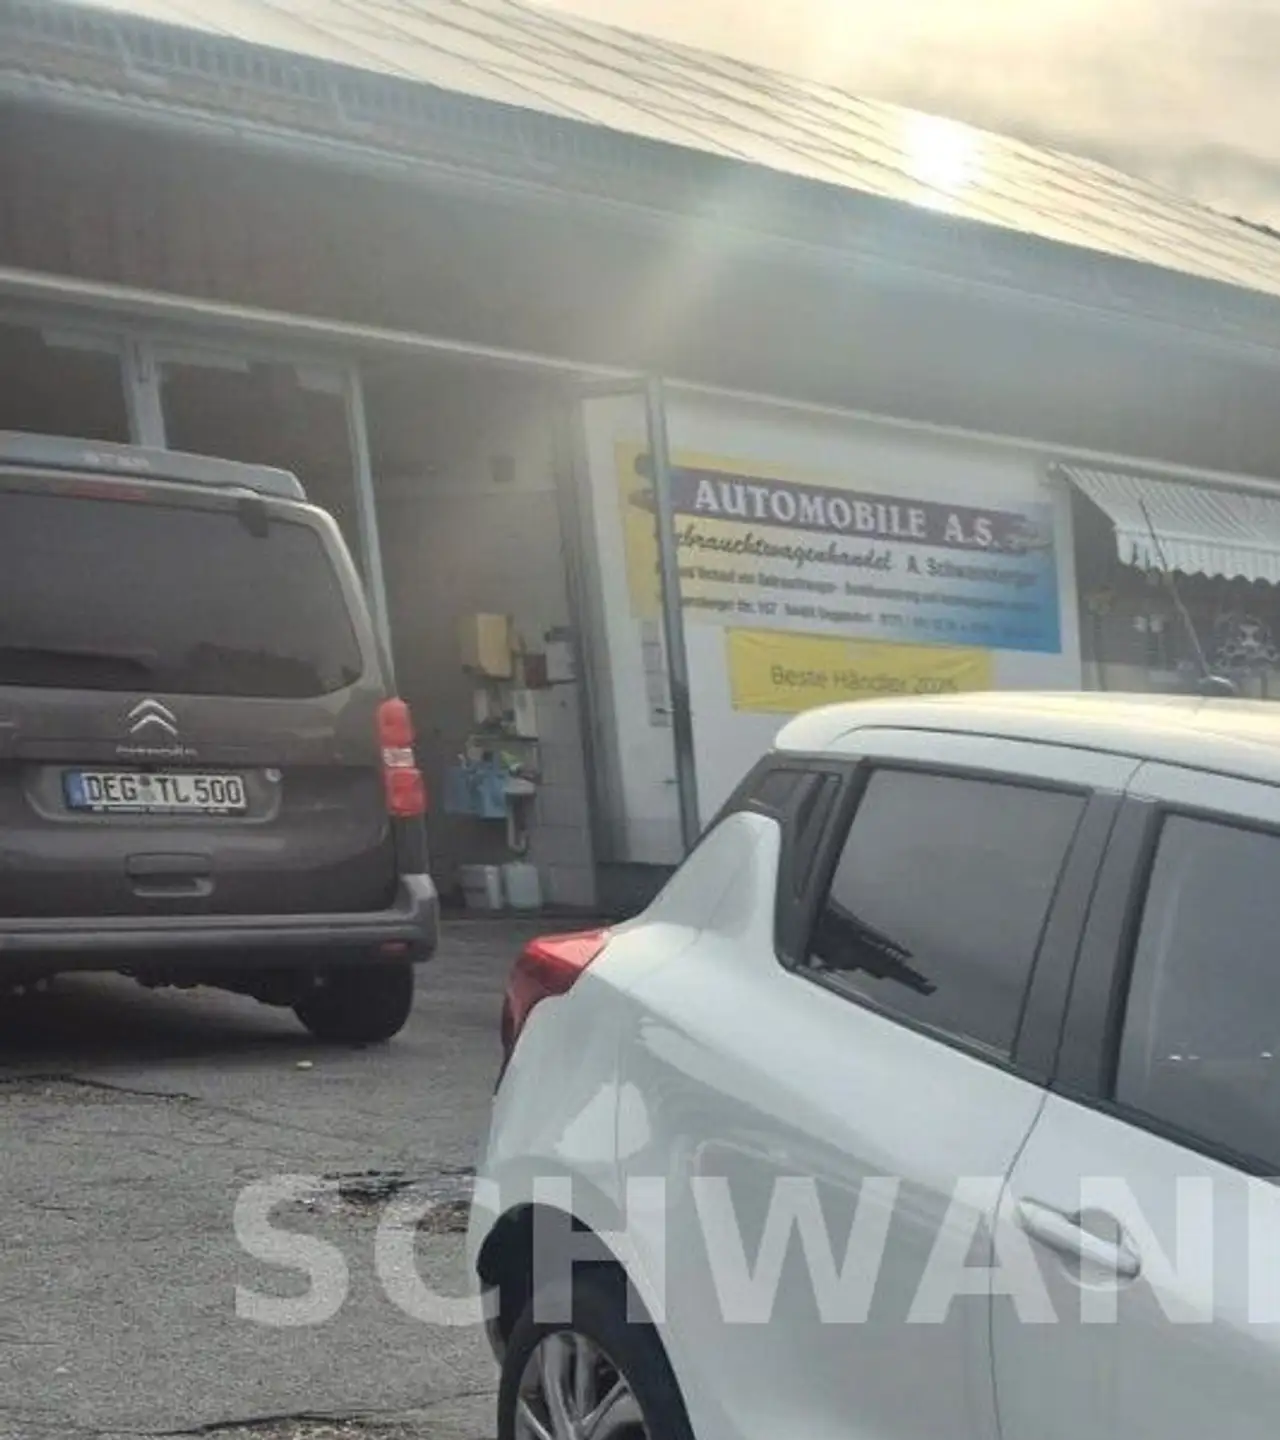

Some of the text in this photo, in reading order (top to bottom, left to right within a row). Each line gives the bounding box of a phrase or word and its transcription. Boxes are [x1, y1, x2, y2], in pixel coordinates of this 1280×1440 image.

[696, 479, 1001, 547] AUTOMOBILE A.S.
[87, 776, 242, 804] DEG TL 500
